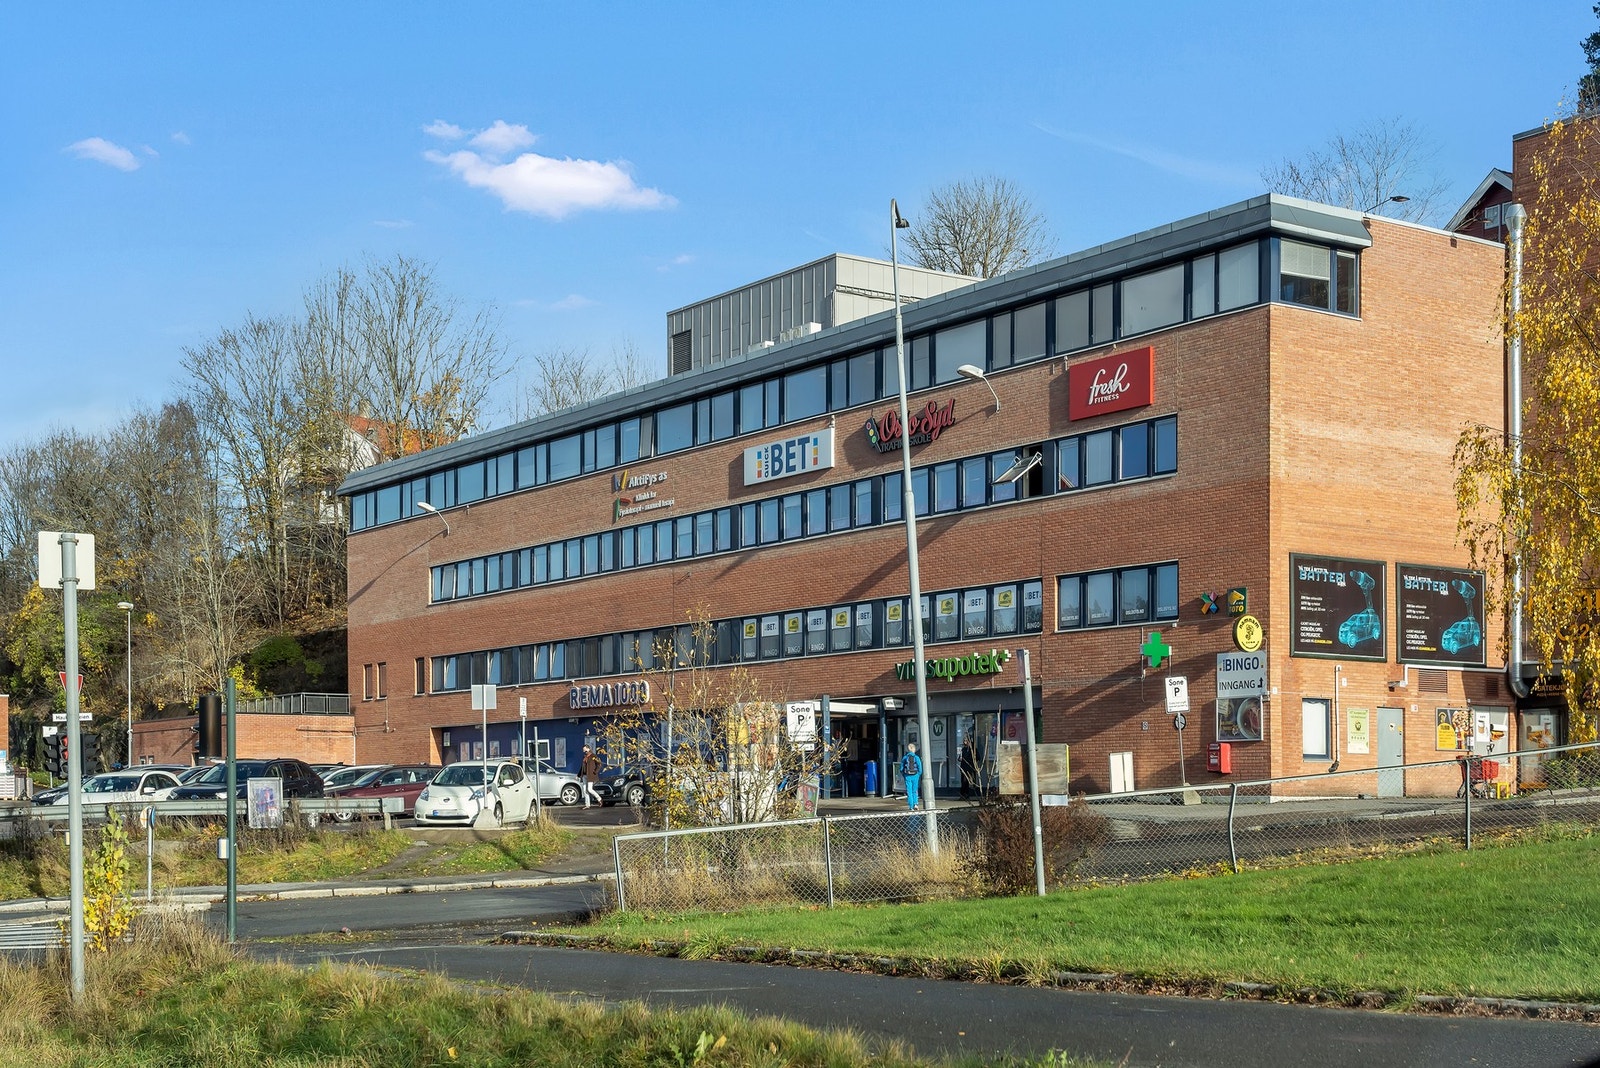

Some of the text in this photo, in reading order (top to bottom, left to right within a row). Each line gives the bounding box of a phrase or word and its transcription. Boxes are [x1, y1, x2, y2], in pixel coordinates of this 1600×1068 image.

[1088, 363, 1130, 405] fresh
[1095, 394, 1120, 404] FITNESS
[880, 398, 954, 442] Oso Syd
[880, 432, 932, 452] TRAFIKSKOLE
[771, 436, 810, 477] BET
[658, 472, 668, 481] as
[1029, 591, 1040, 600] BET
[968, 626, 984, 634] BINGO
[895, 649, 1003, 682] vitsapotek
[1226, 657, 1259, 671] BINGO
[1219, 680, 1255, 690] INNGANG
[570, 680, 650, 709] REMA 1000
[1174, 687, 1180, 697] P
[798, 715, 804, 725] P
